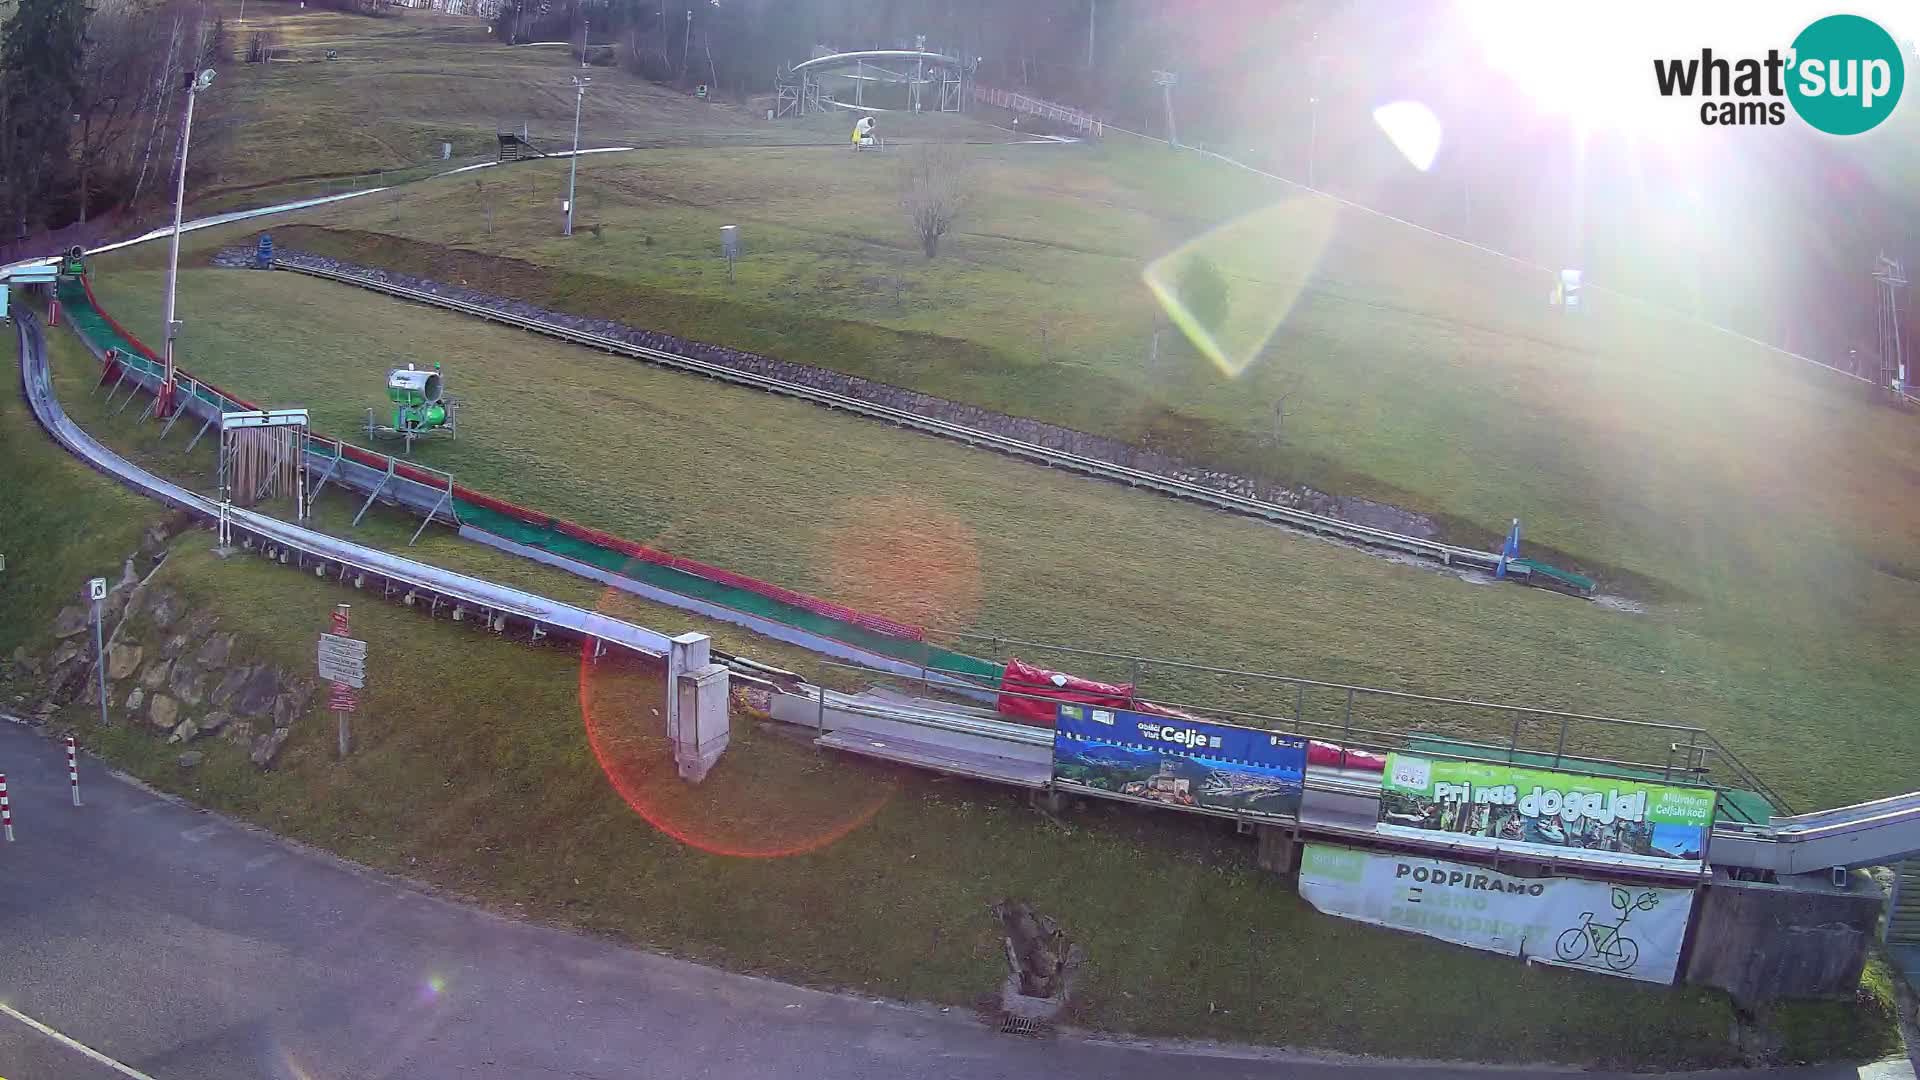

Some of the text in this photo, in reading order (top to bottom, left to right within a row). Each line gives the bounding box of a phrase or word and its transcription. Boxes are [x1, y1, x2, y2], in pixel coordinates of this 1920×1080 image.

[1161, 726, 1207, 748] Celje
[1433, 781, 1470, 803] Pri
[1474, 784, 1517, 805] nas
[1396, 863, 1545, 897] PODPIRAMO
